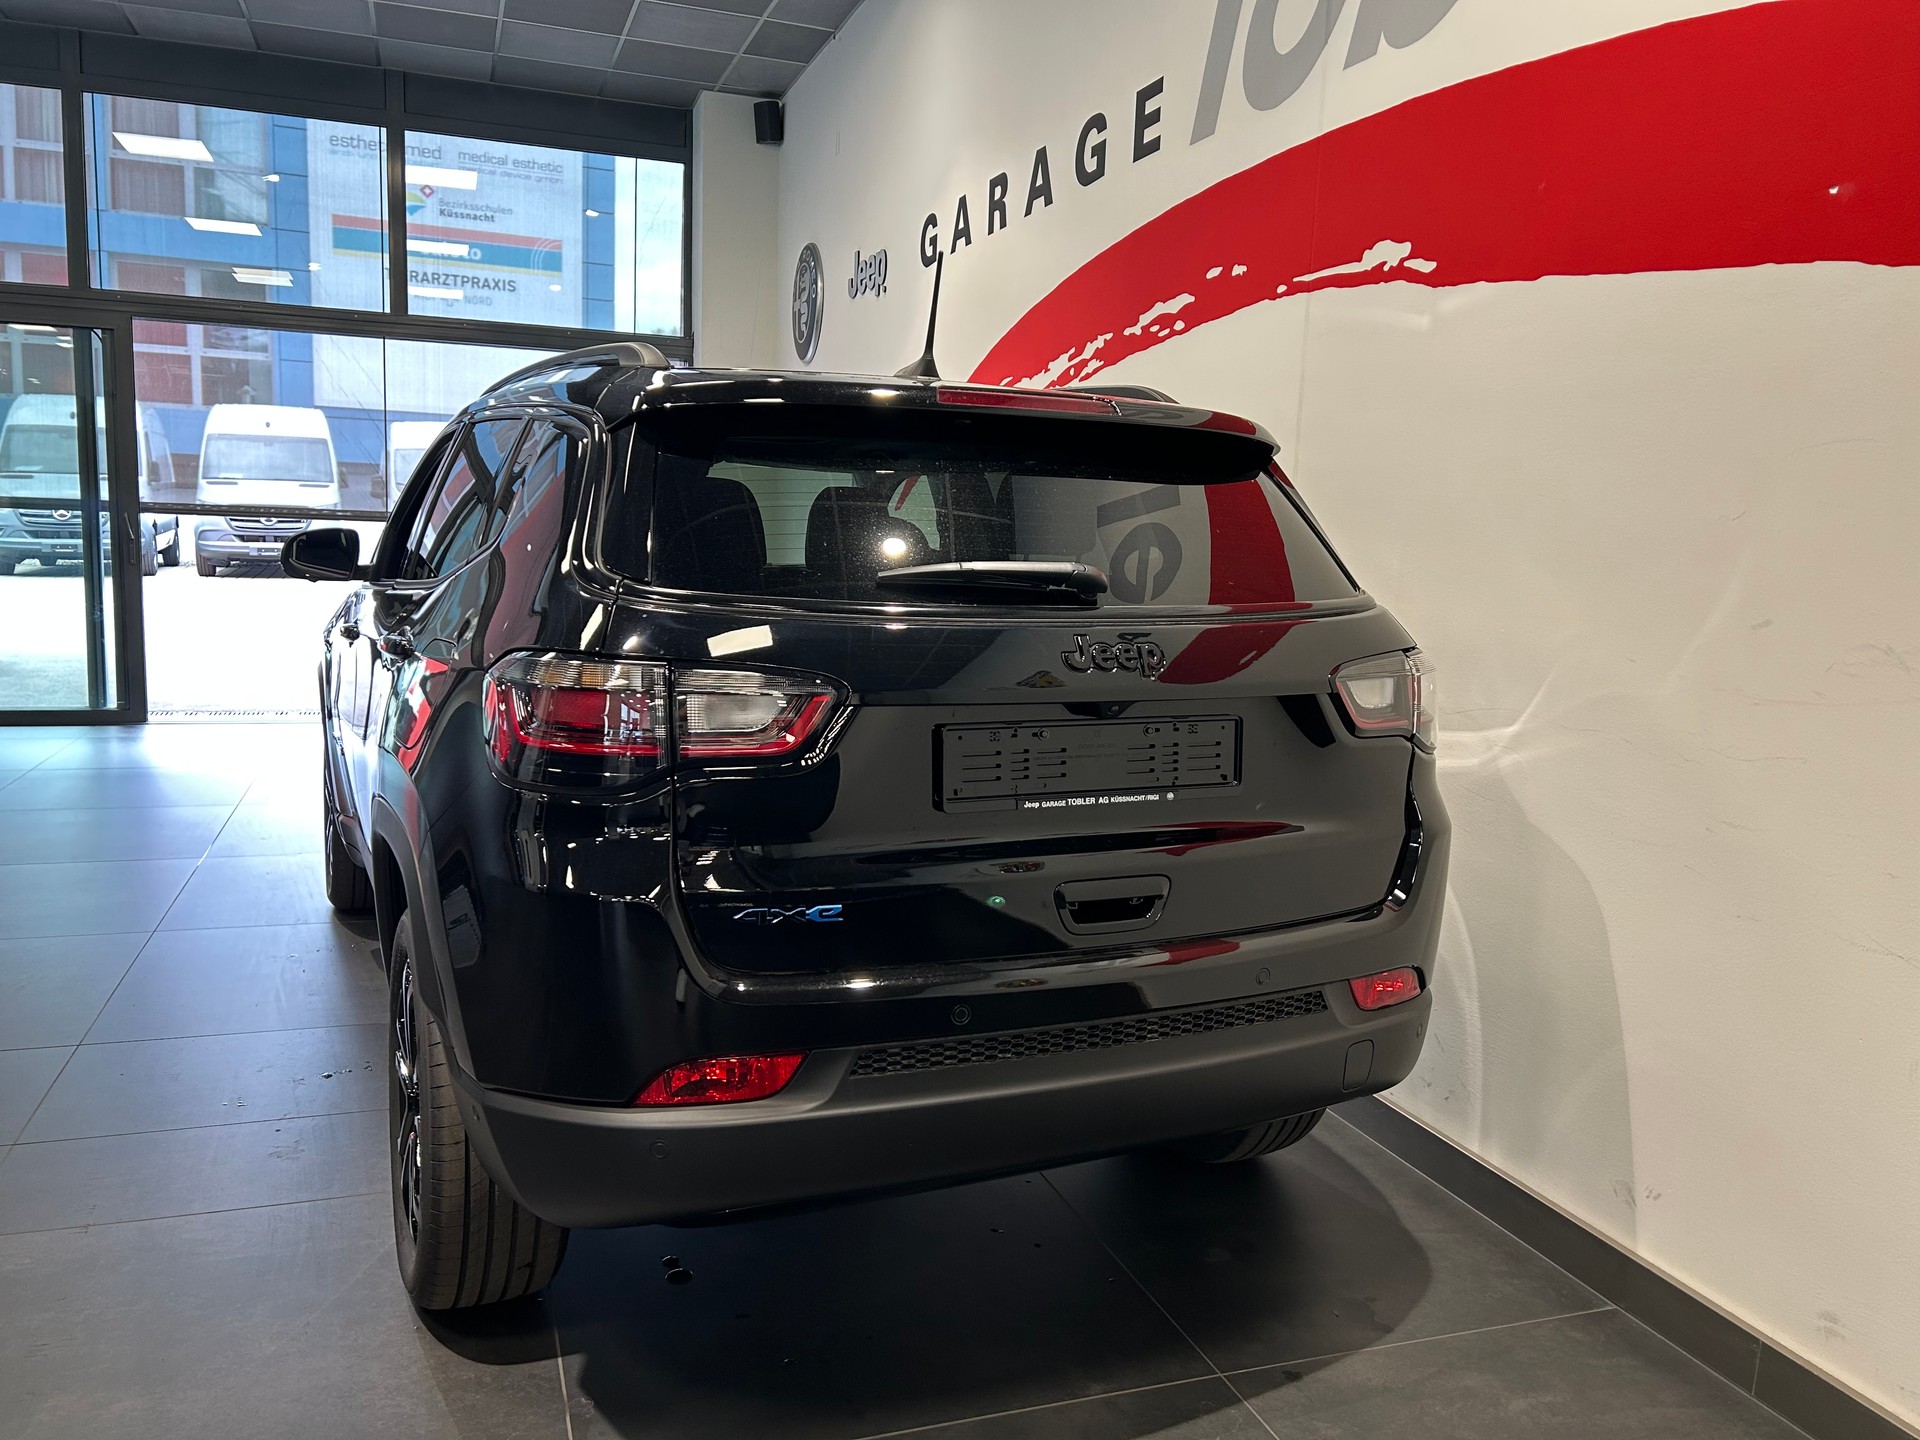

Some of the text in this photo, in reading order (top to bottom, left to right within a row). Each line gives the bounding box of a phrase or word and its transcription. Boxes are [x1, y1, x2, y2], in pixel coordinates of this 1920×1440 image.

[458, 151, 508, 166] medical
[512, 158, 563, 174] esthetic
[920, 75, 1164, 268] GARAGE
[439, 197, 513, 216] Bezirksschulen
[439, 208, 496, 223] Küssnacht
[848, 248, 888, 300] Jeep
[1061, 633, 1167, 682] Jeep
[1067, 797, 1096, 806] TOBLER
[1098, 796, 1109, 804] AG
